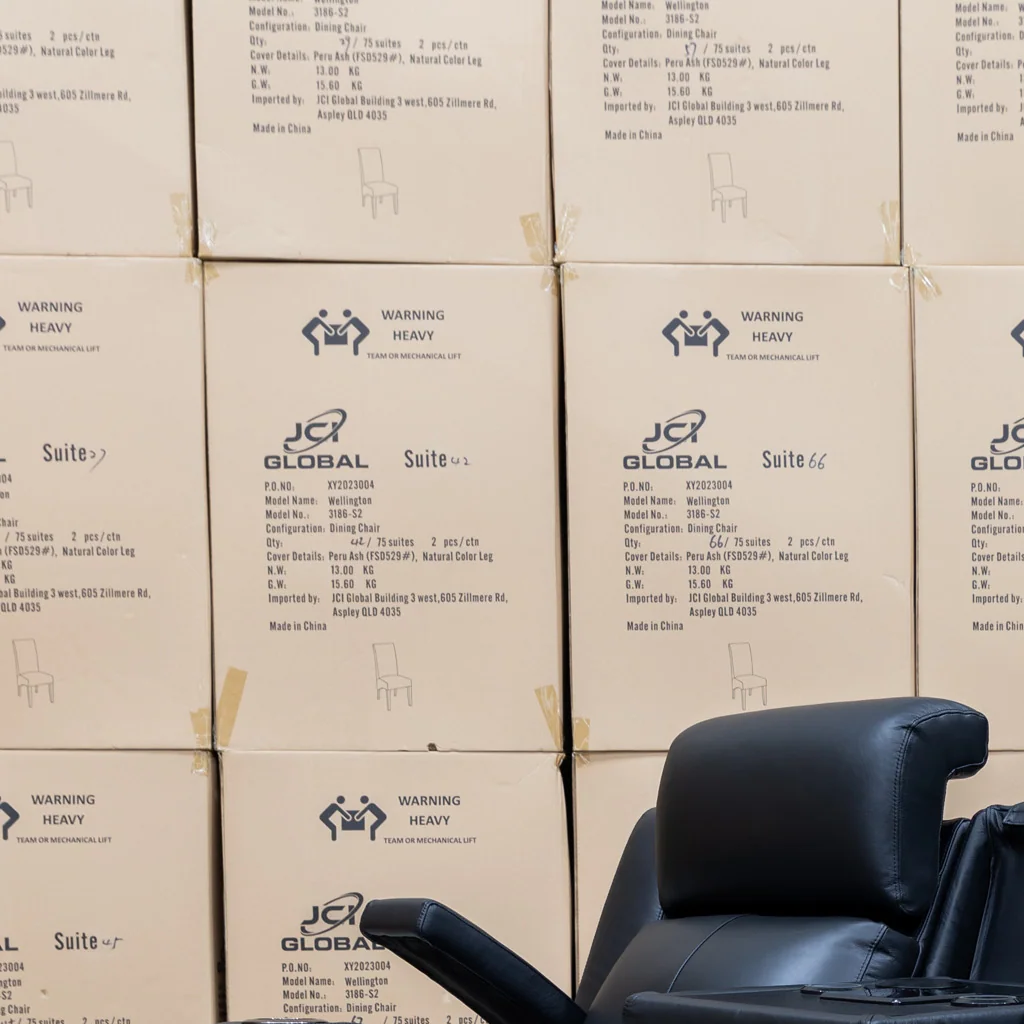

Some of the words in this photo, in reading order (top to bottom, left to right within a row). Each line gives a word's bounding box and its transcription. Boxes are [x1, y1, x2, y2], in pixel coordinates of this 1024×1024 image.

[666, 28, 693, 40] Dining
[694, 29, 717, 39] Chair
[317, 109, 345, 121] Aspley
[347, 110, 364, 120] QLD
[366, 110, 388, 120] 4035
[605, 130, 626, 140] Made
[629, 130, 636, 140] in
[639, 130, 662, 140] China
[957, 132, 978, 142] Made
[981, 132, 988, 142] in
[990, 131, 1014, 141] China
[17, 301, 84, 313] WARNING
[381, 309, 445, 321] WARNING
[741, 311, 804, 322] WARNING
[29, 322, 73, 333] HEAVY
[392, 330, 434, 341] HEAVY
[752, 331, 793, 343] HEAVY
[400, 352, 446, 360] MECHANICAL
[42, 444, 87, 462] Suite
[264, 455, 368, 469] GLOBAL
[404, 450, 447, 468] Suite
[622, 455, 727, 470] GLOBAL
[762, 450, 805, 469] Suite
[808, 452, 827, 471] 66
[327, 479, 374, 490] XY2023004
[686, 480, 733, 490] XY2023004
[265, 496, 289, 506] Model
[291, 496, 317, 506] Name:
[328, 495, 372, 507] Wellington
[265, 510, 290, 520] Model
[328, 509, 363, 519] 3186-S2
[266, 523, 325, 535] Configuration:
[329, 523, 356, 534] Dining
[358, 523, 380, 533] Chair
[266, 551, 290, 561] Cover
[292, 551, 324, 562] Details:
[329, 551, 347, 561] Peru
[349, 551, 364, 561] Ash
[365, 550, 418, 562] (FSD529#),
[423, 552, 453, 562] Natural
[455, 551, 477, 561] Color
[479, 551, 493, 563] Leg
[268, 593, 306, 604] Imported
[307, 594, 320, 605] by:
[332, 593, 345, 603] JCI
[346, 593, 372, 603] Global
[374, 593, 409, 604] Building
[410, 593, 416, 602] 3
[458, 593, 493, 603] Zillmere
[494, 592, 508, 604] Rd,
[332, 607, 360, 618] Aspley
[361, 607, 378, 617] QLD
[380, 606, 401, 616] 4035
[269, 621, 291, 631] Made
[293, 621, 301, 631] in
[303, 621, 327, 631] China
[626, 621, 649, 631] Made
[650, 621, 658, 631] in
[660, 621, 684, 631] China
[31, 794, 96, 805] WARNING
[398, 795, 461, 806] WARNING
[42, 814, 85, 825] HEAVY
[409, 815, 451, 826] HEAVY
[49, 836, 97, 844] MECHANICAL
[54, 932, 98, 950] Suite
[344, 961, 391, 971] XY2023004
[283, 990, 307, 1000] Model
[345, 989, 379, 998] 3186-S2
